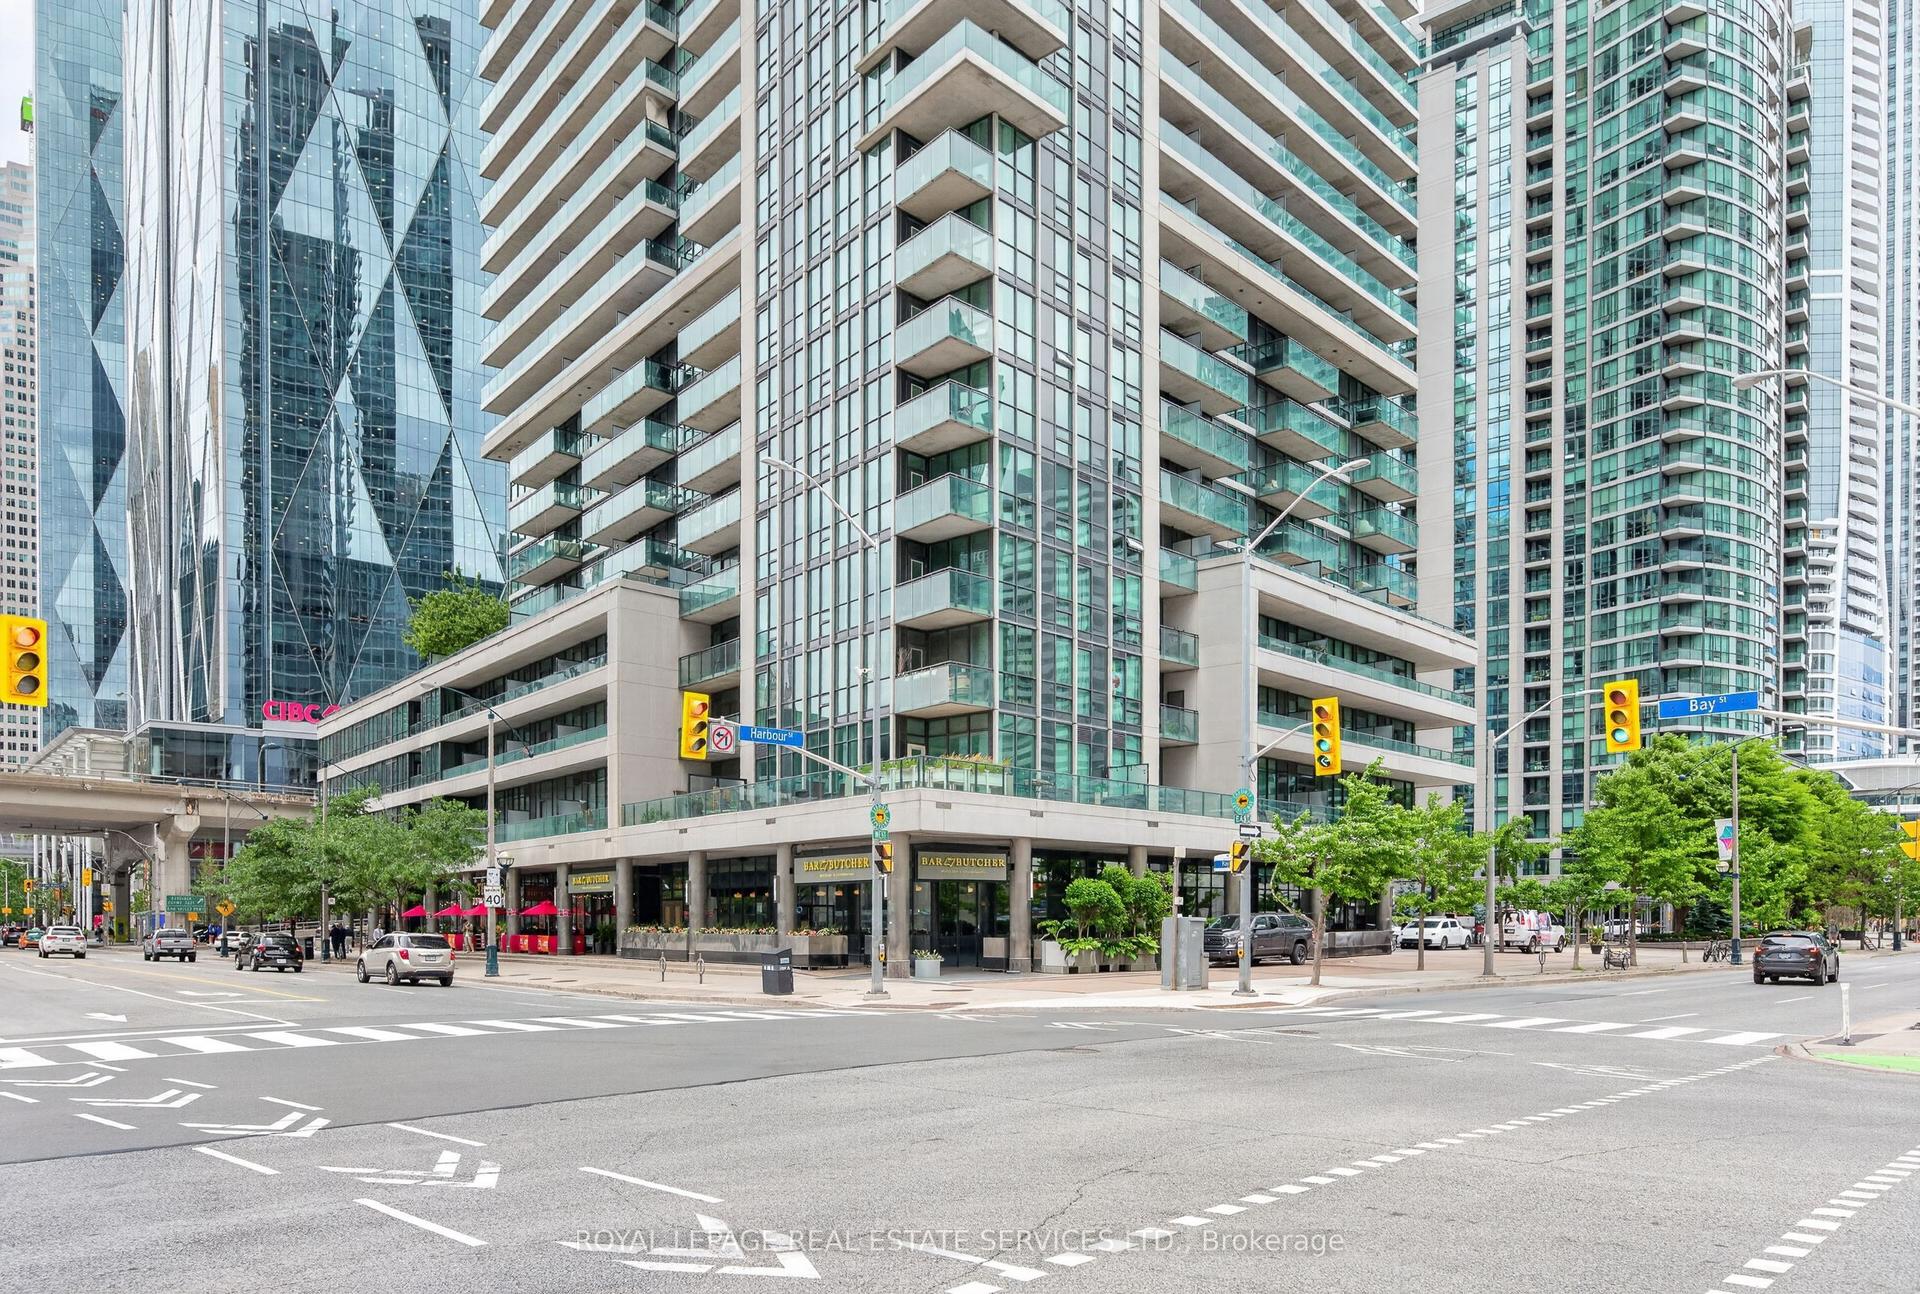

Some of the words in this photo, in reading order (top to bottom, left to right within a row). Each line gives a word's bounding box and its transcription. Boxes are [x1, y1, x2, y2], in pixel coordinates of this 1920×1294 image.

[262, 700, 321, 724] CIBC
[1689, 699, 1716, 713] Bay
[750, 727, 788, 741] Harbour
[921, 857, 942, 866] BAR
[955, 858, 1006, 867] BUTCHER
[486, 894, 501, 905] 40
